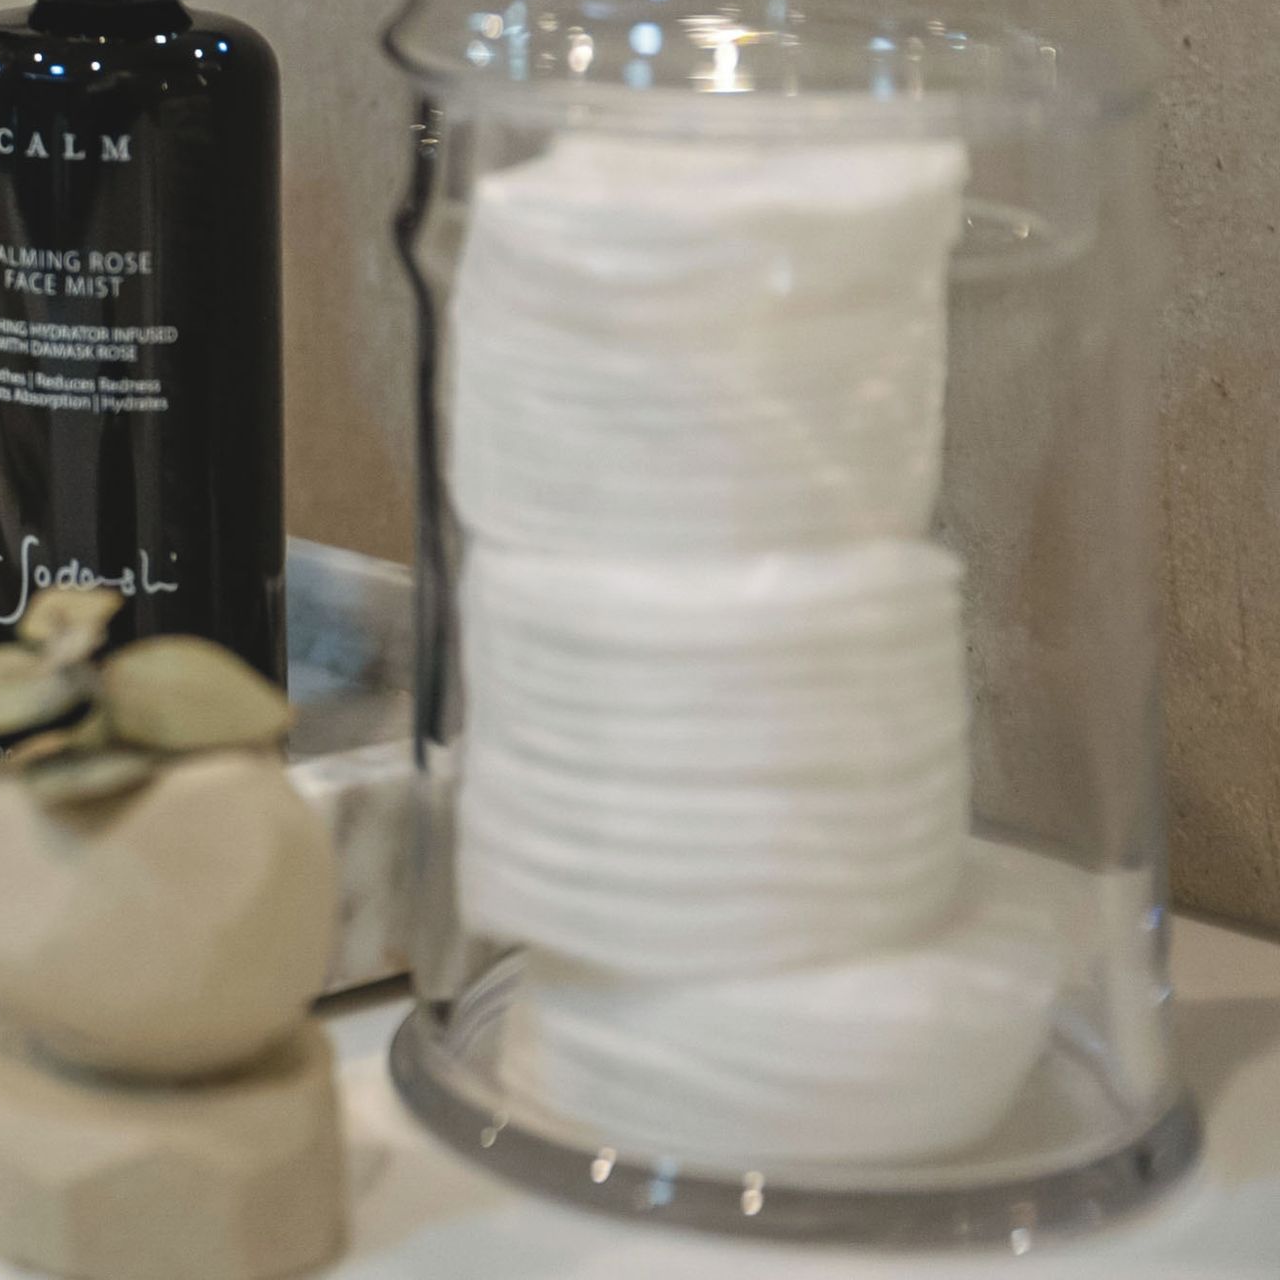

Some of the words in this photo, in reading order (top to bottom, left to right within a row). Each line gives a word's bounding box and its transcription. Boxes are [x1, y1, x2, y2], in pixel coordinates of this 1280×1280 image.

[89, 250, 152, 275] ROSE
[4, 269, 57, 296] FACE
[64, 275, 125, 299] MIST
[111, 325, 178, 344] INFUSED
[30, 339, 95, 360] DAMASK
[96, 344, 138, 362] ROSE
[35, 371, 96, 393] Reduces
